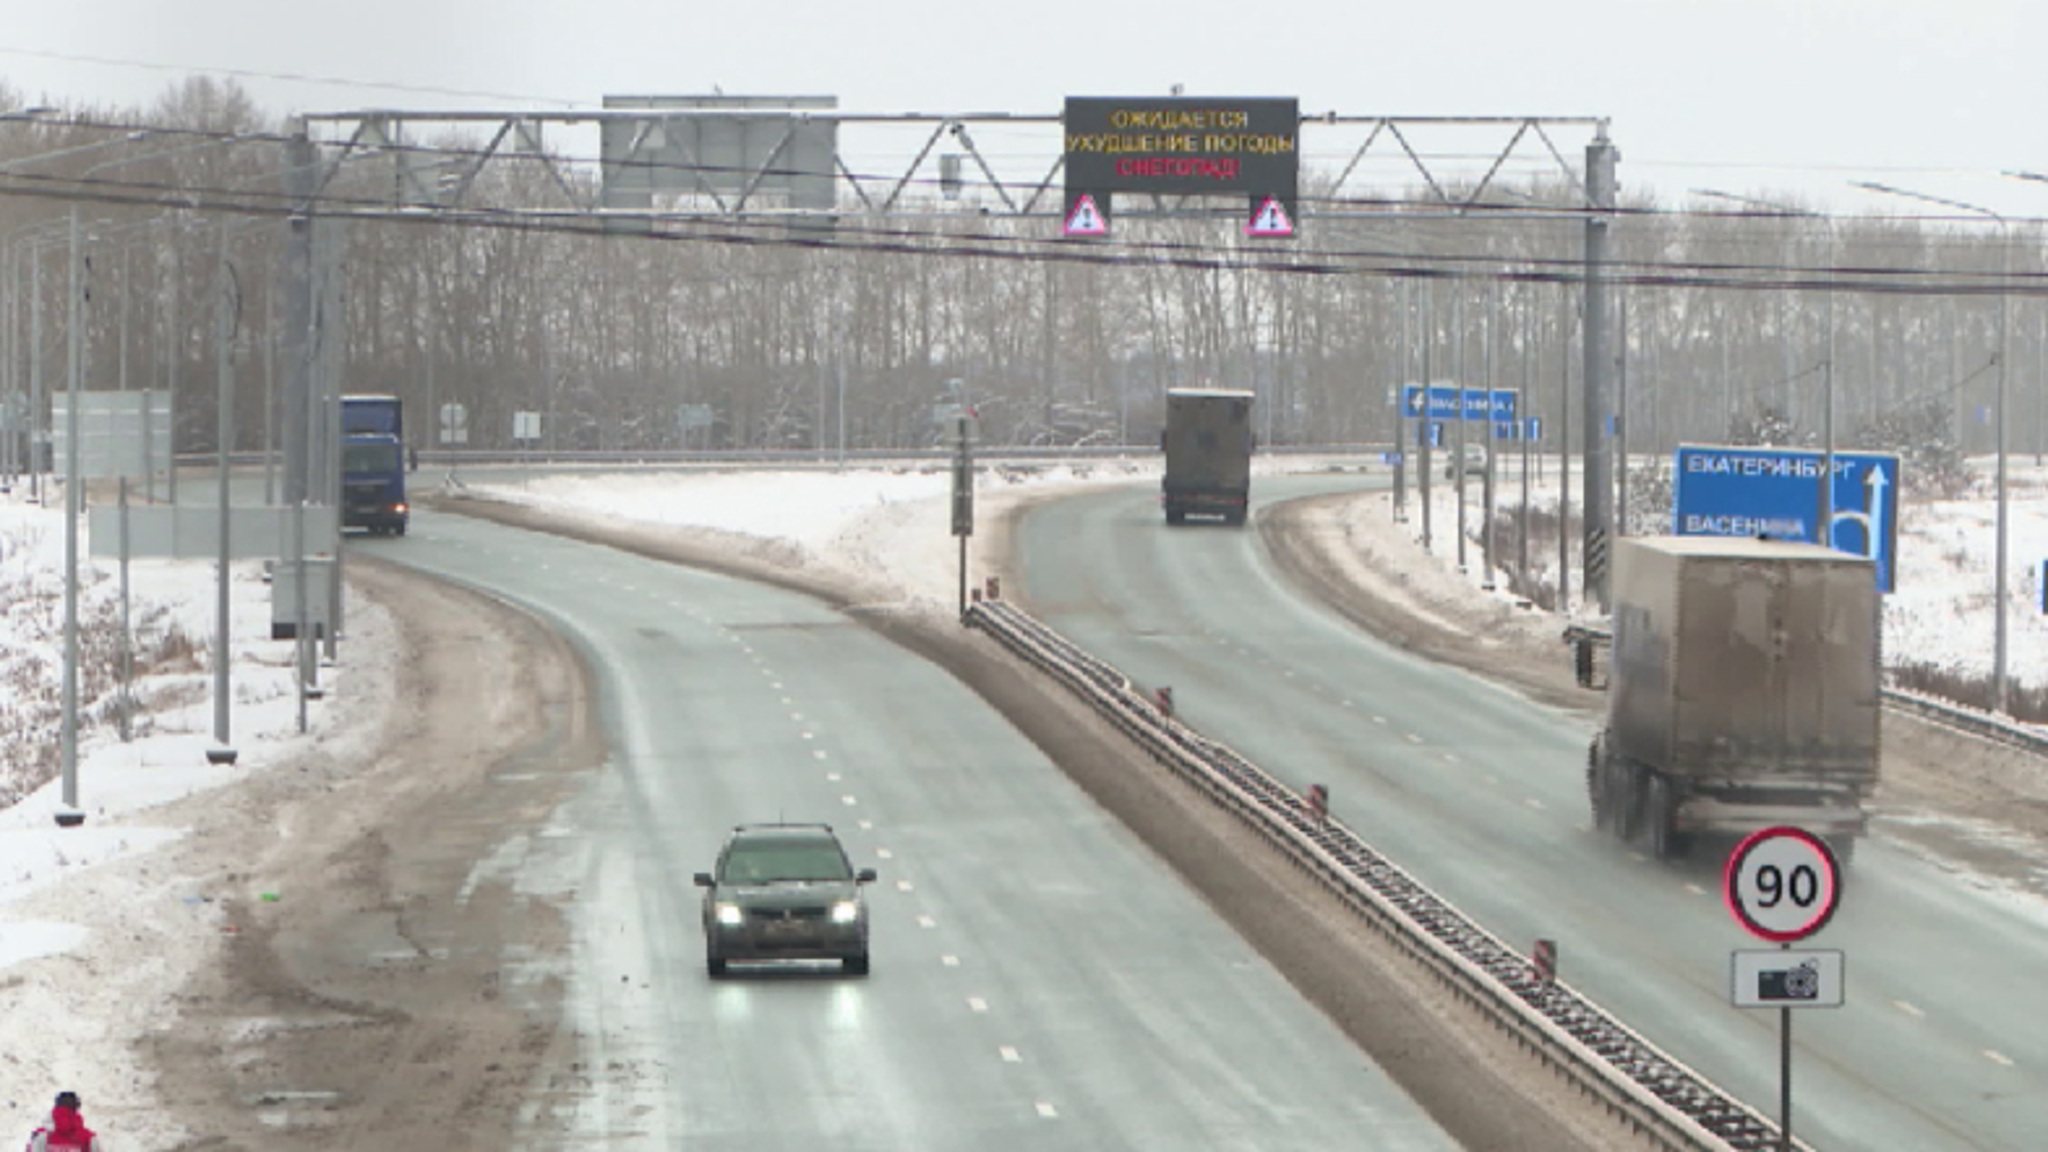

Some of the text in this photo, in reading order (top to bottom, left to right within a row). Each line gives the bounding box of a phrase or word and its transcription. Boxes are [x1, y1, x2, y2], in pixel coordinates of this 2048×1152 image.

[1111, 109, 1248, 129] ОЖИДАЕТСЯ
[1066, 133, 1294, 154] УХУДШЕНИЕ ПОГОДЫ
[1686, 454, 1856, 479] ЕКАТЕРИНБУРГ
[1756, 864, 1818, 907] 90
